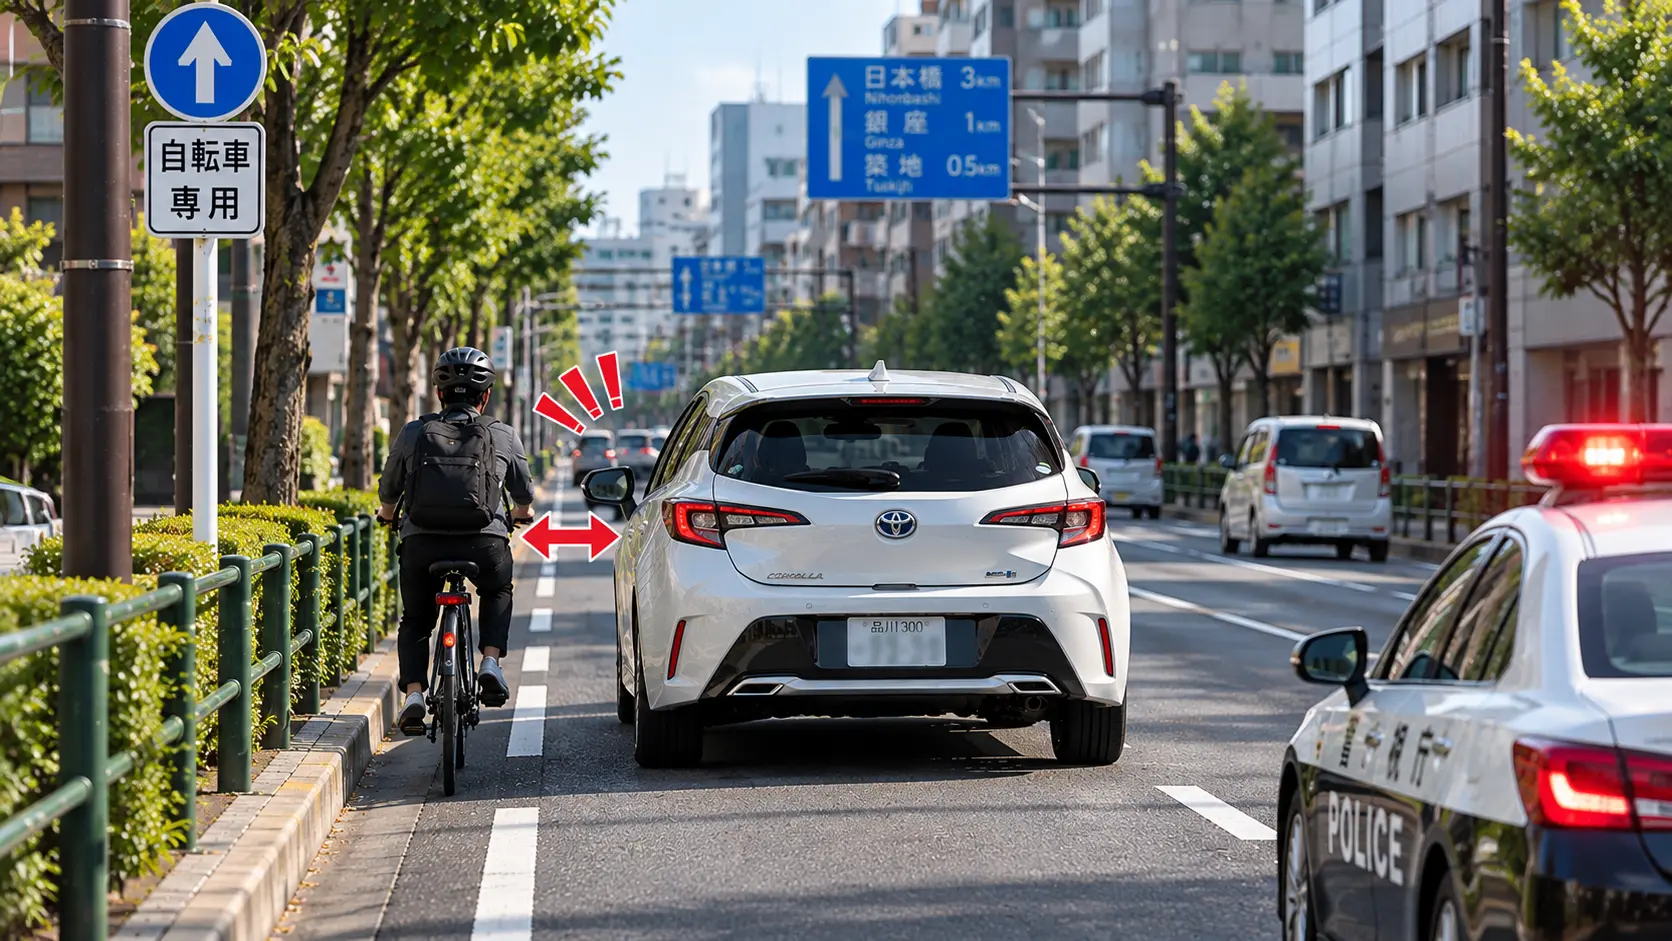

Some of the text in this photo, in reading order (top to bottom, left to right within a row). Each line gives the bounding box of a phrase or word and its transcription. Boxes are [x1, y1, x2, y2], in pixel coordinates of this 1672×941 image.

[865, 65, 1001, 90] 日本橋 3km
[865, 110, 1001, 134] 銀座 1km
[865, 136, 904, 149] Ginza
[162, 138, 250, 173] 自転車
[865, 154, 923, 178] 築地
[170, 185, 238, 220] 専用
[1328, 790, 1404, 887] POLICE
